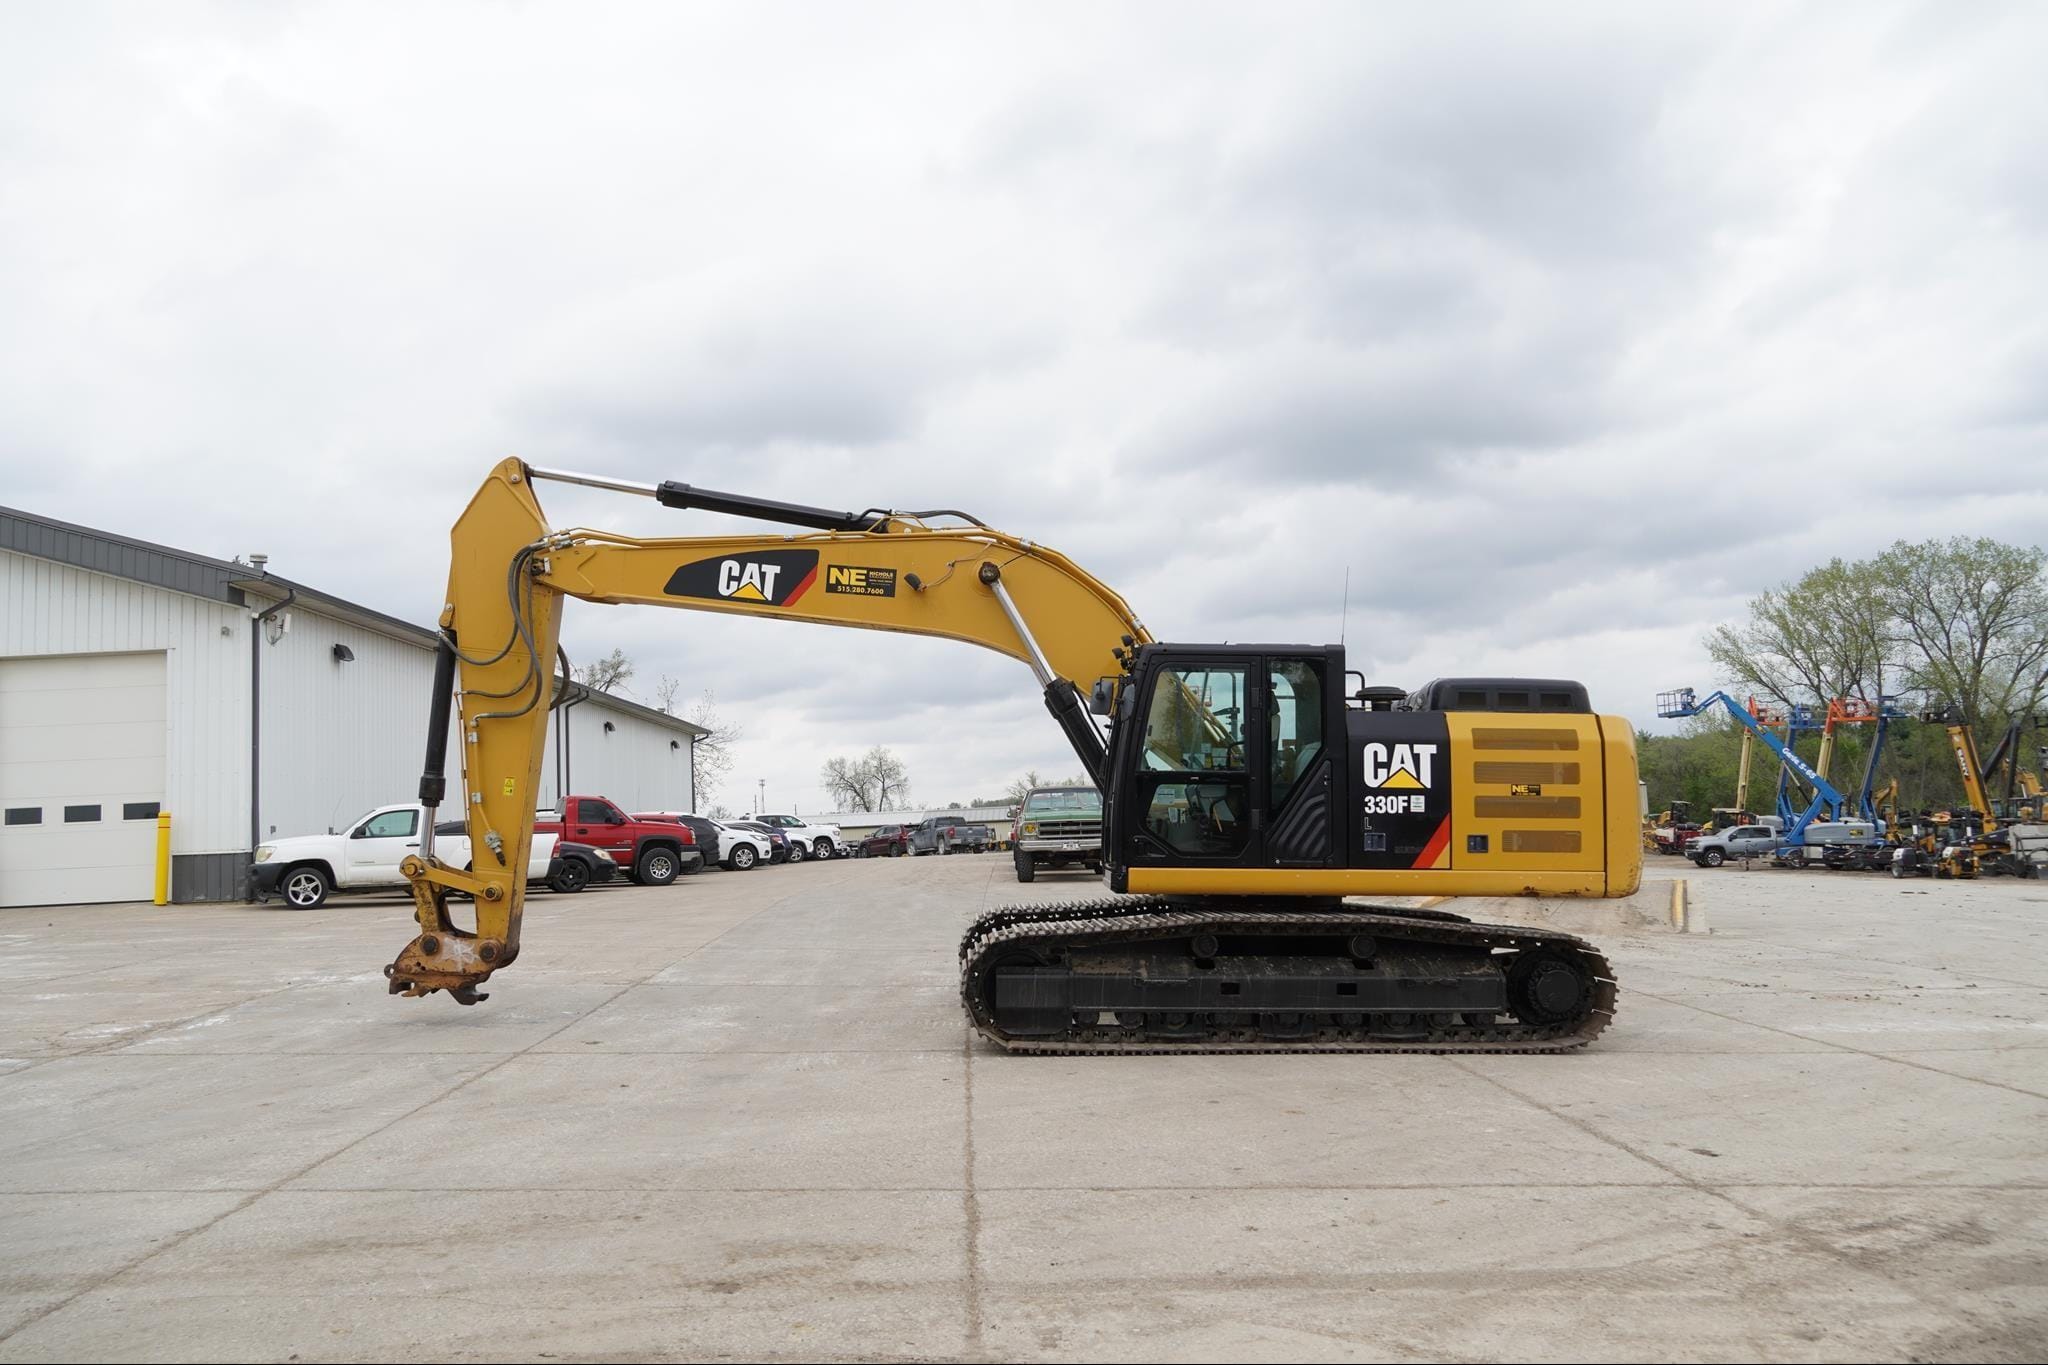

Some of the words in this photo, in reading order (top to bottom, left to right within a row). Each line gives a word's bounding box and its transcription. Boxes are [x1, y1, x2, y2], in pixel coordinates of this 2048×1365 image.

[718, 560, 781, 601] CAT
[829, 567, 867, 586] NE
[837, 586, 884, 595] 515.280.7600
[1363, 742, 1438, 789] CAT
[1512, 784, 1529, 793] NE
[1364, 795, 1408, 814] 330F
